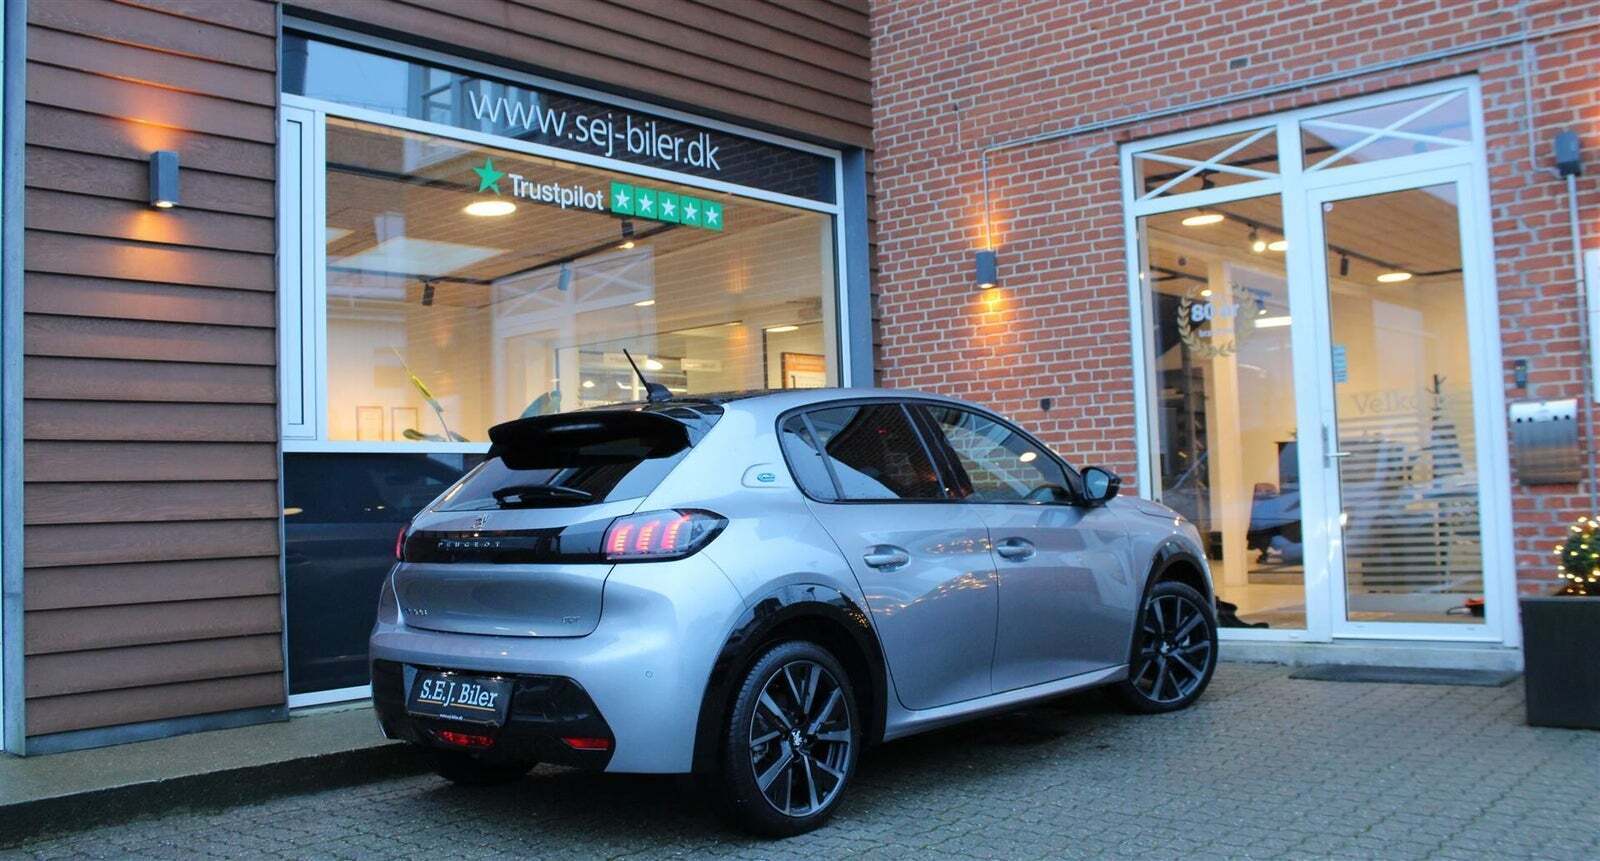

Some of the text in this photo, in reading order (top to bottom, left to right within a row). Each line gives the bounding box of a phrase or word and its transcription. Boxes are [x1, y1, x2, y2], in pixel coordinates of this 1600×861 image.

[468, 90, 721, 171] www.sej-biler.dk
[508, 173, 605, 211] Trustpilot
[1190, 302, 1214, 322] 80
[420, 679, 498, 707] S.E.J. Biler
